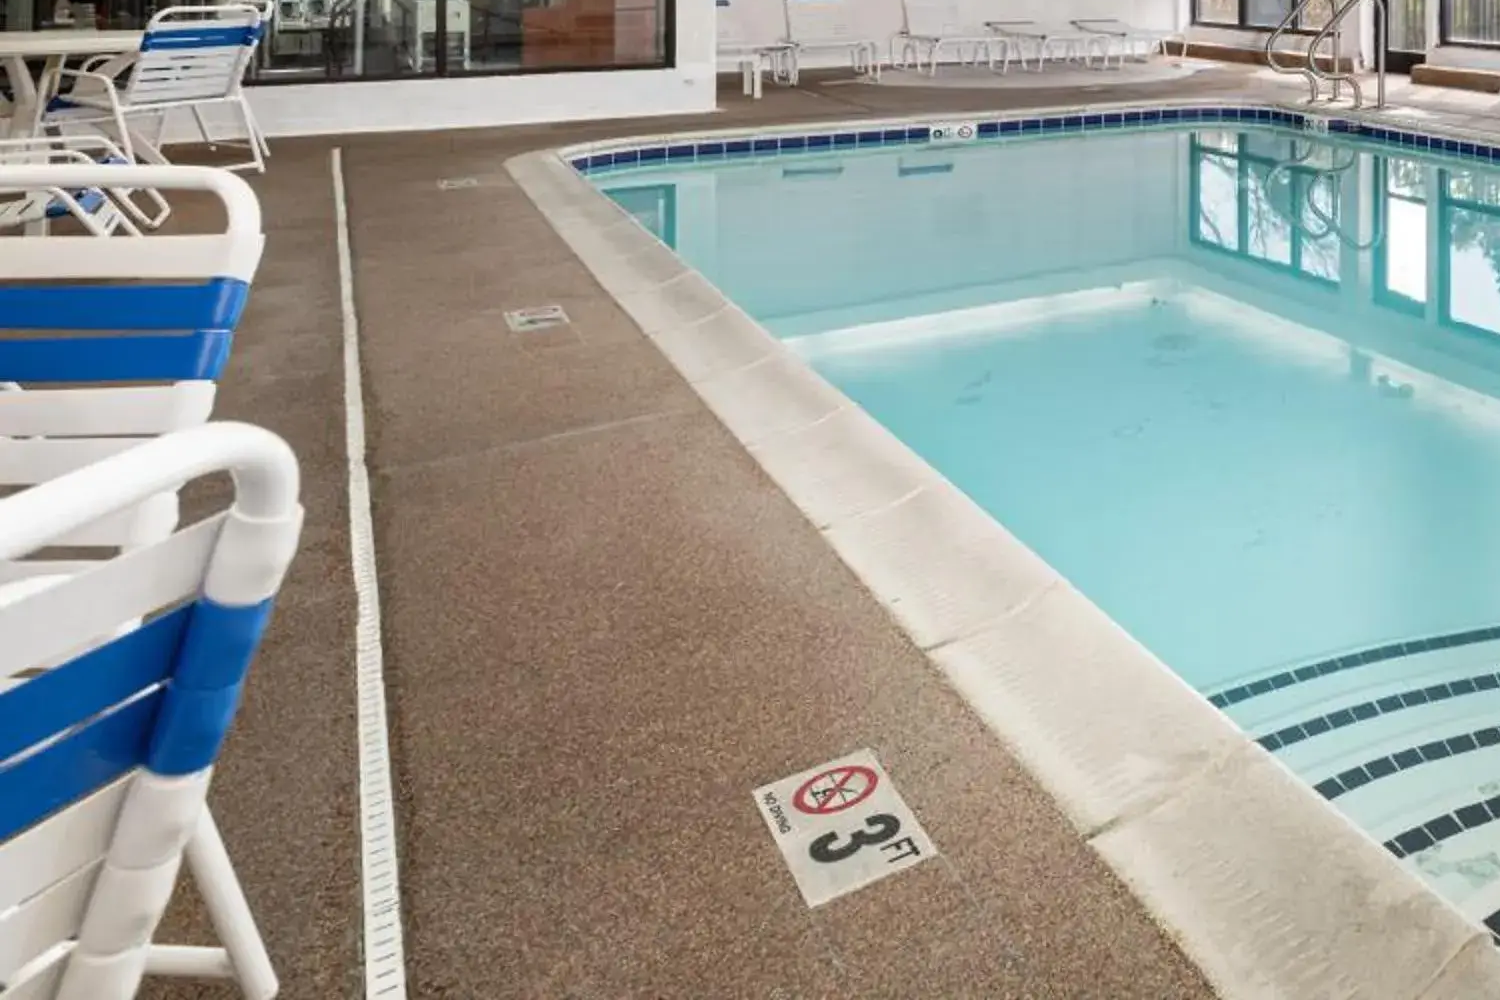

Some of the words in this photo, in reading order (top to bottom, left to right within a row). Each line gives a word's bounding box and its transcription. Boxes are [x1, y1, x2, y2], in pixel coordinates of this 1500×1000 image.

[763, 791, 777, 804] NO
[770, 804, 792, 834] DIVING
[809, 814, 900, 863] 3
[879, 837, 921, 863] FT
